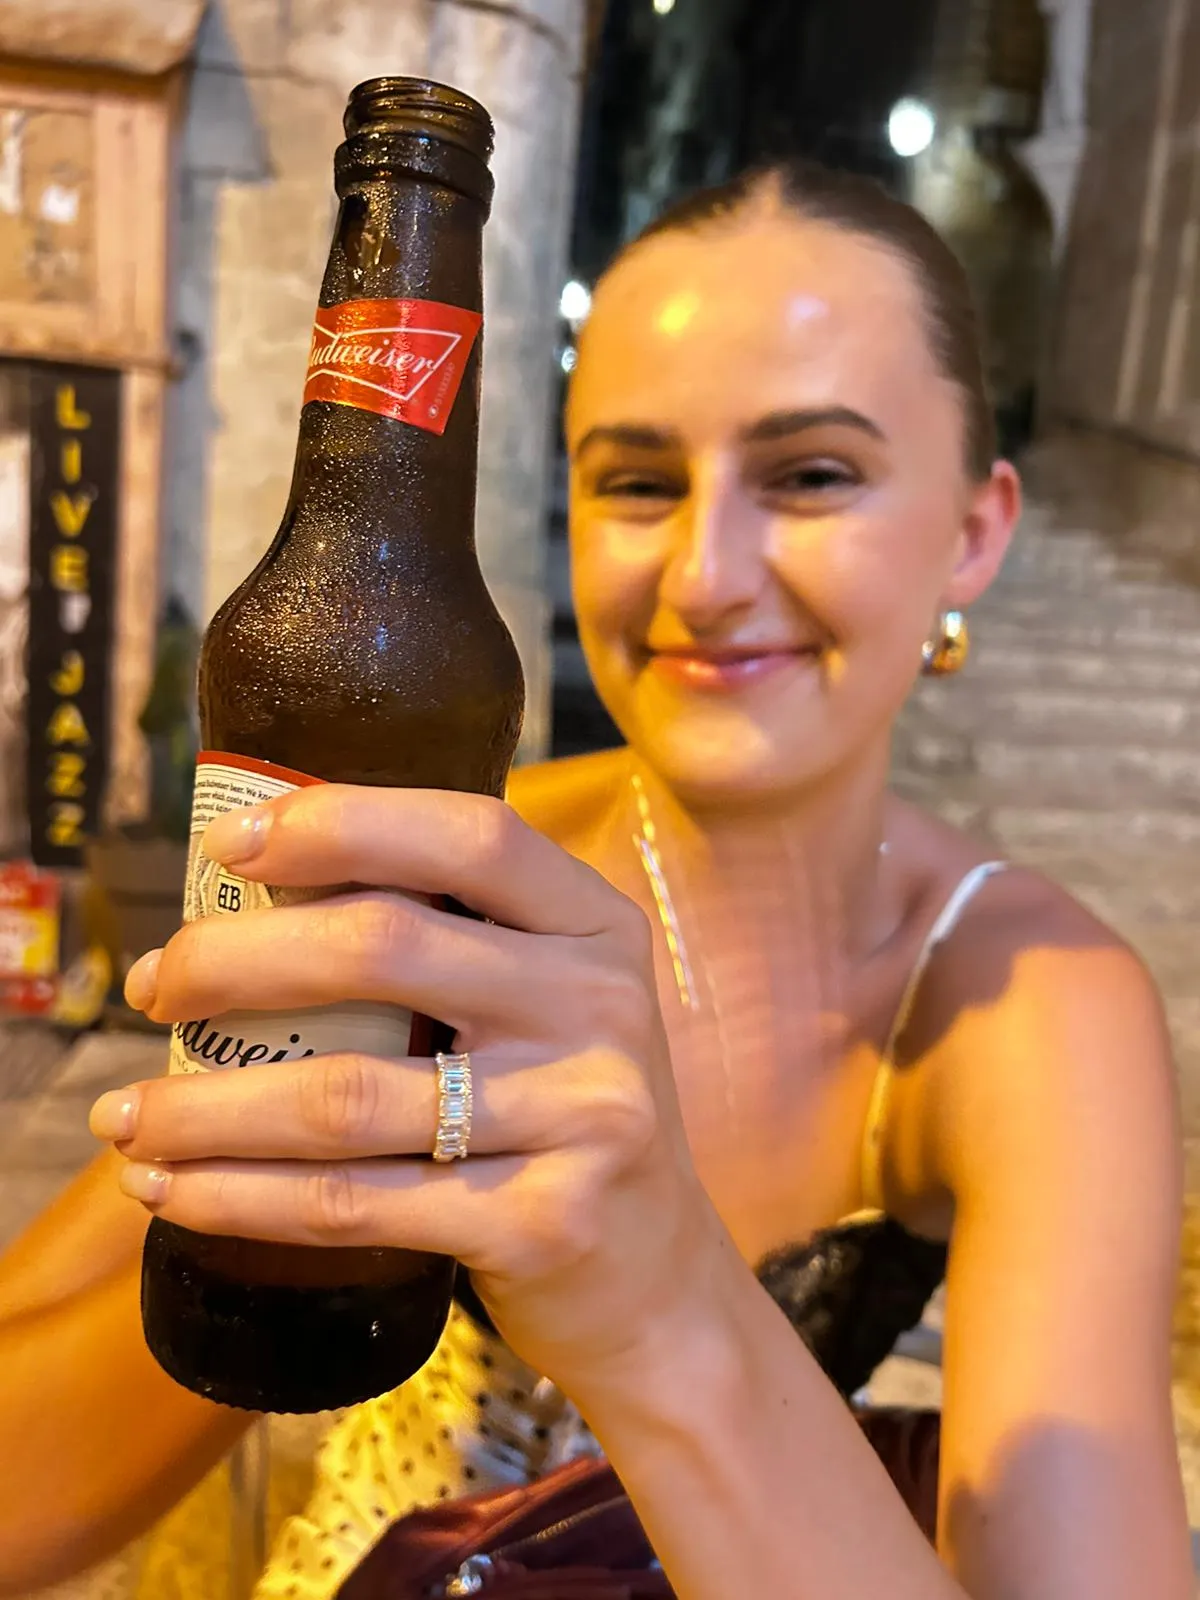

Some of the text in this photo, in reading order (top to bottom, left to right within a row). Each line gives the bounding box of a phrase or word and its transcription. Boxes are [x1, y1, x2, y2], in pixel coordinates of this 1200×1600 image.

[308, 332, 434, 373] udweiser
[46, 383, 91, 847] LIVE JAZZ
[217, 882, 241, 913] AB
